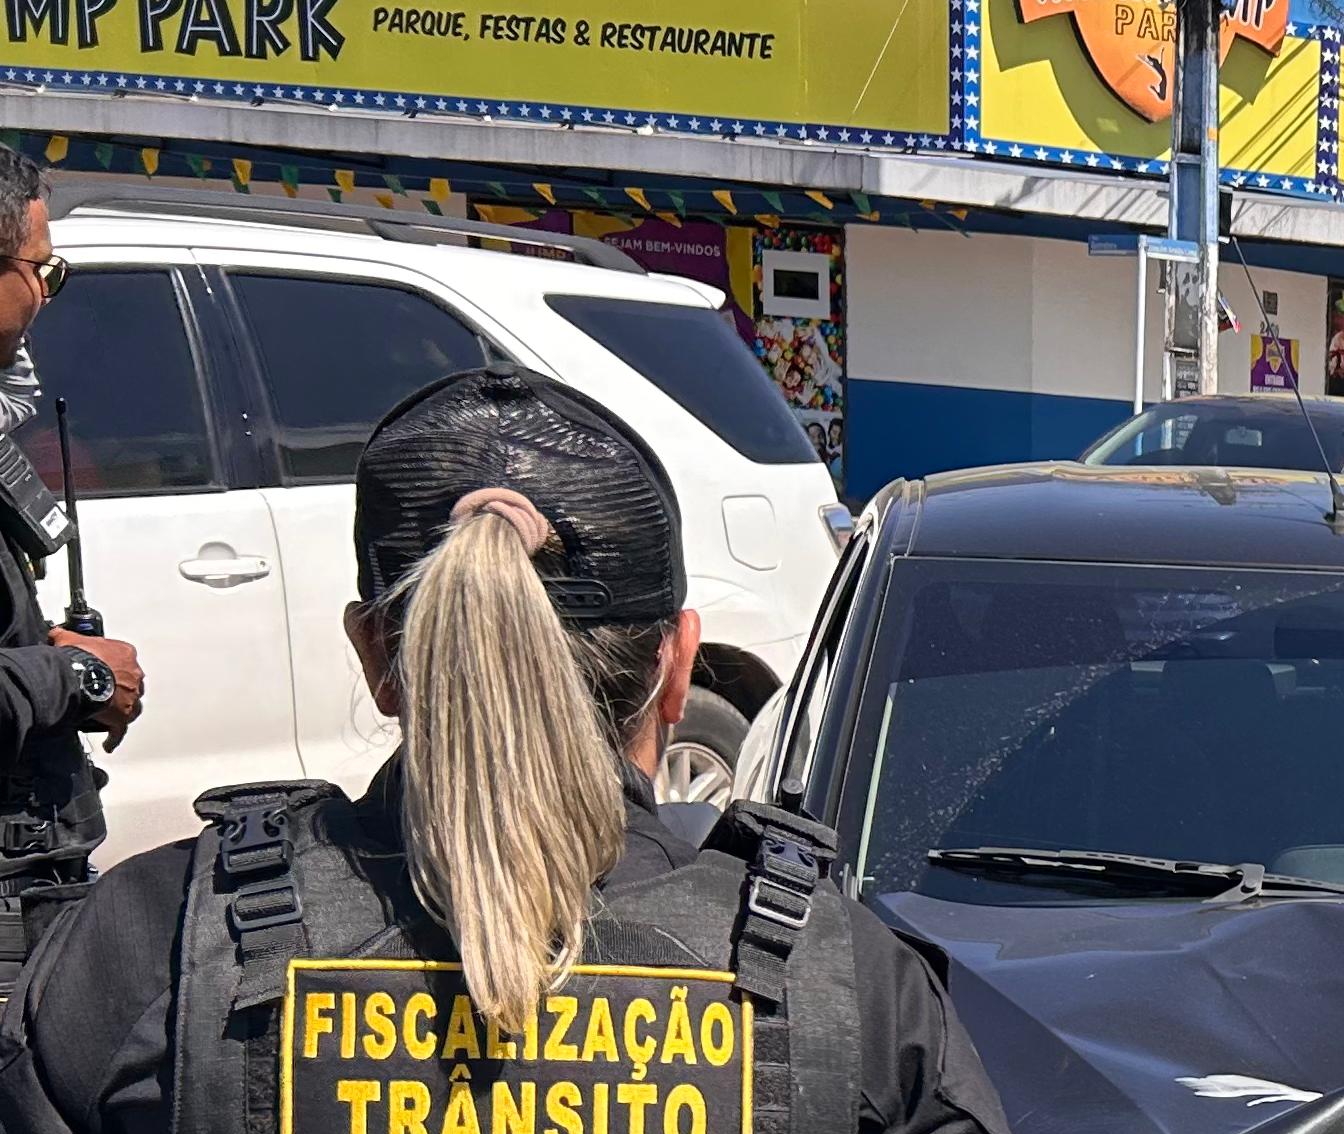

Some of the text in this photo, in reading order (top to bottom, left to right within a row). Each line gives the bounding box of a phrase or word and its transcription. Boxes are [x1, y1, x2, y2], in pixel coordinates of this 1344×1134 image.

[138, 0, 346, 62] PARK
[372, 7, 776, 60] PARQUE, FESTAS & RESTAURANTE
[1115, 4, 1177, 42] PAR
[645, 240, 722, 258] BEM-VINDOS
[303, 985, 734, 1081] FISCALIZAÇÃO
